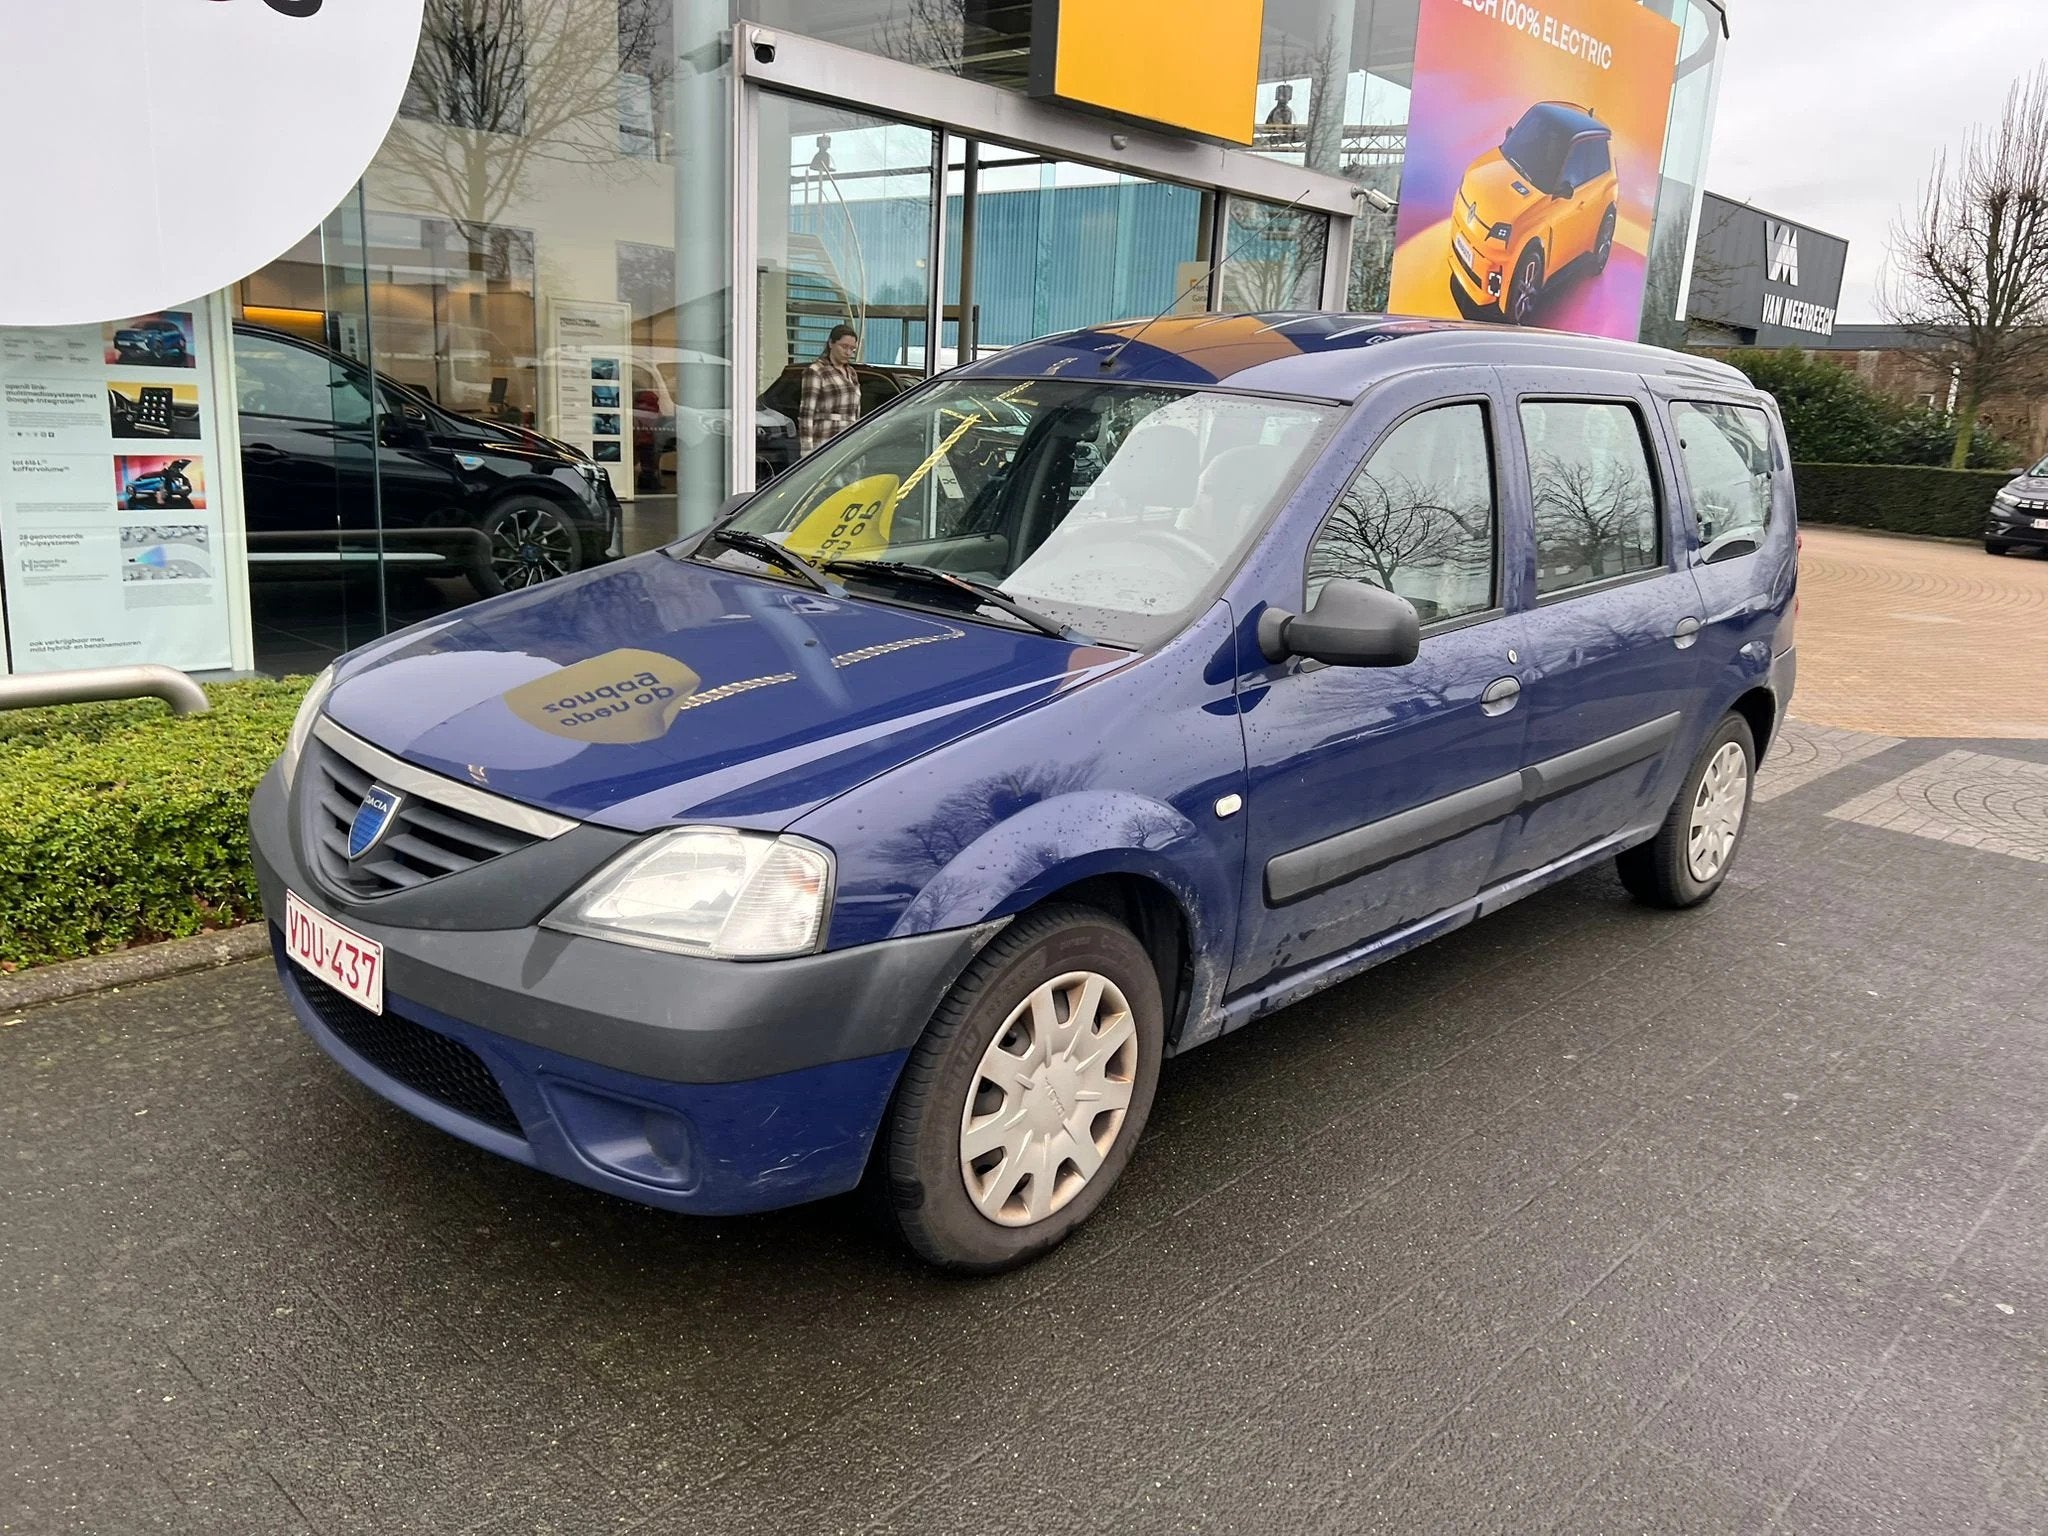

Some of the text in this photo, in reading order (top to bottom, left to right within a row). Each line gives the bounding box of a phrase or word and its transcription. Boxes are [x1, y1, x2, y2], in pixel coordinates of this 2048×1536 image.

[1500, 0, 1541, 38] 100%
[1543, 15, 1612, 69] ELECTRIC
[1761, 293, 1835, 336] VAN MEERBEECK
[365, 795, 388, 812] DACIA
